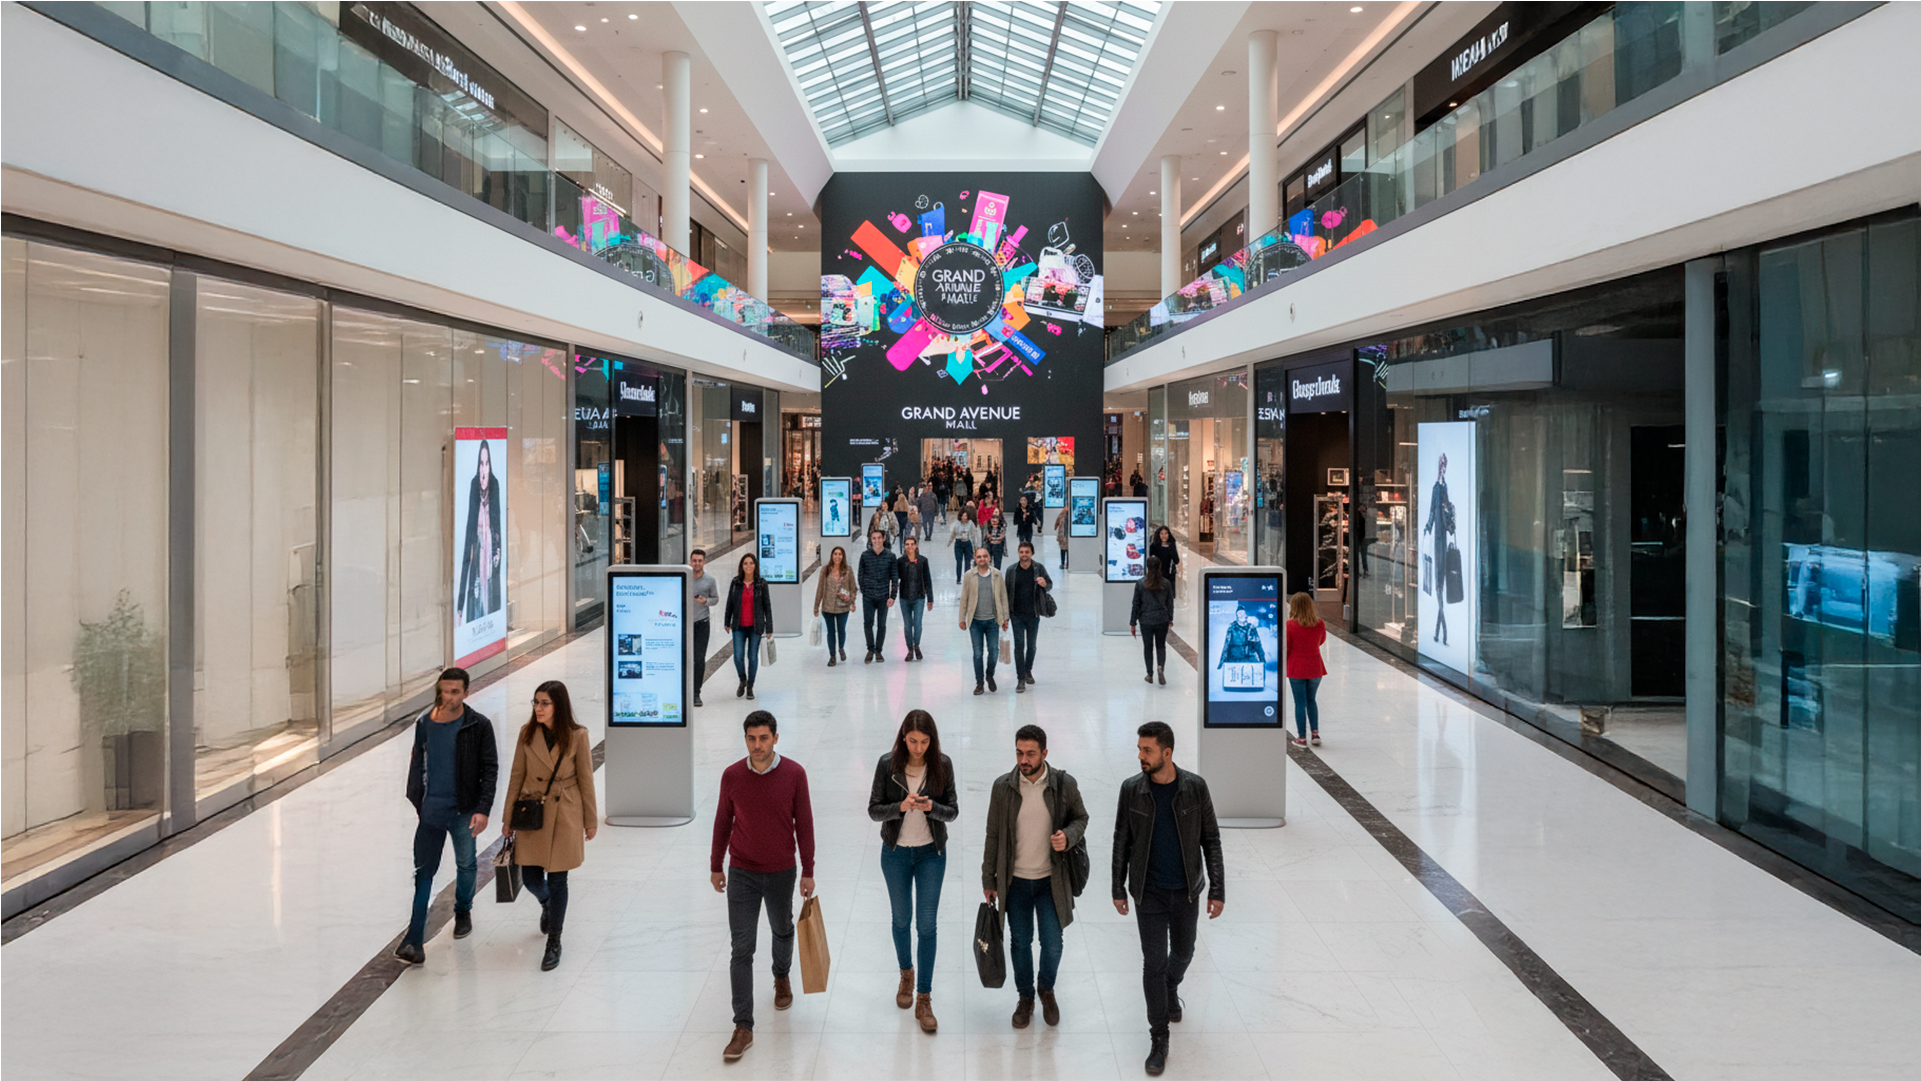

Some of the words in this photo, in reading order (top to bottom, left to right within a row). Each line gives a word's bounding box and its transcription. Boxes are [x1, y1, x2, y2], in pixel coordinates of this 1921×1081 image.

[932, 269, 986, 282] GRAND
[901, 406, 956, 420] GRAND
[960, 406, 1020, 420] AVENUE
